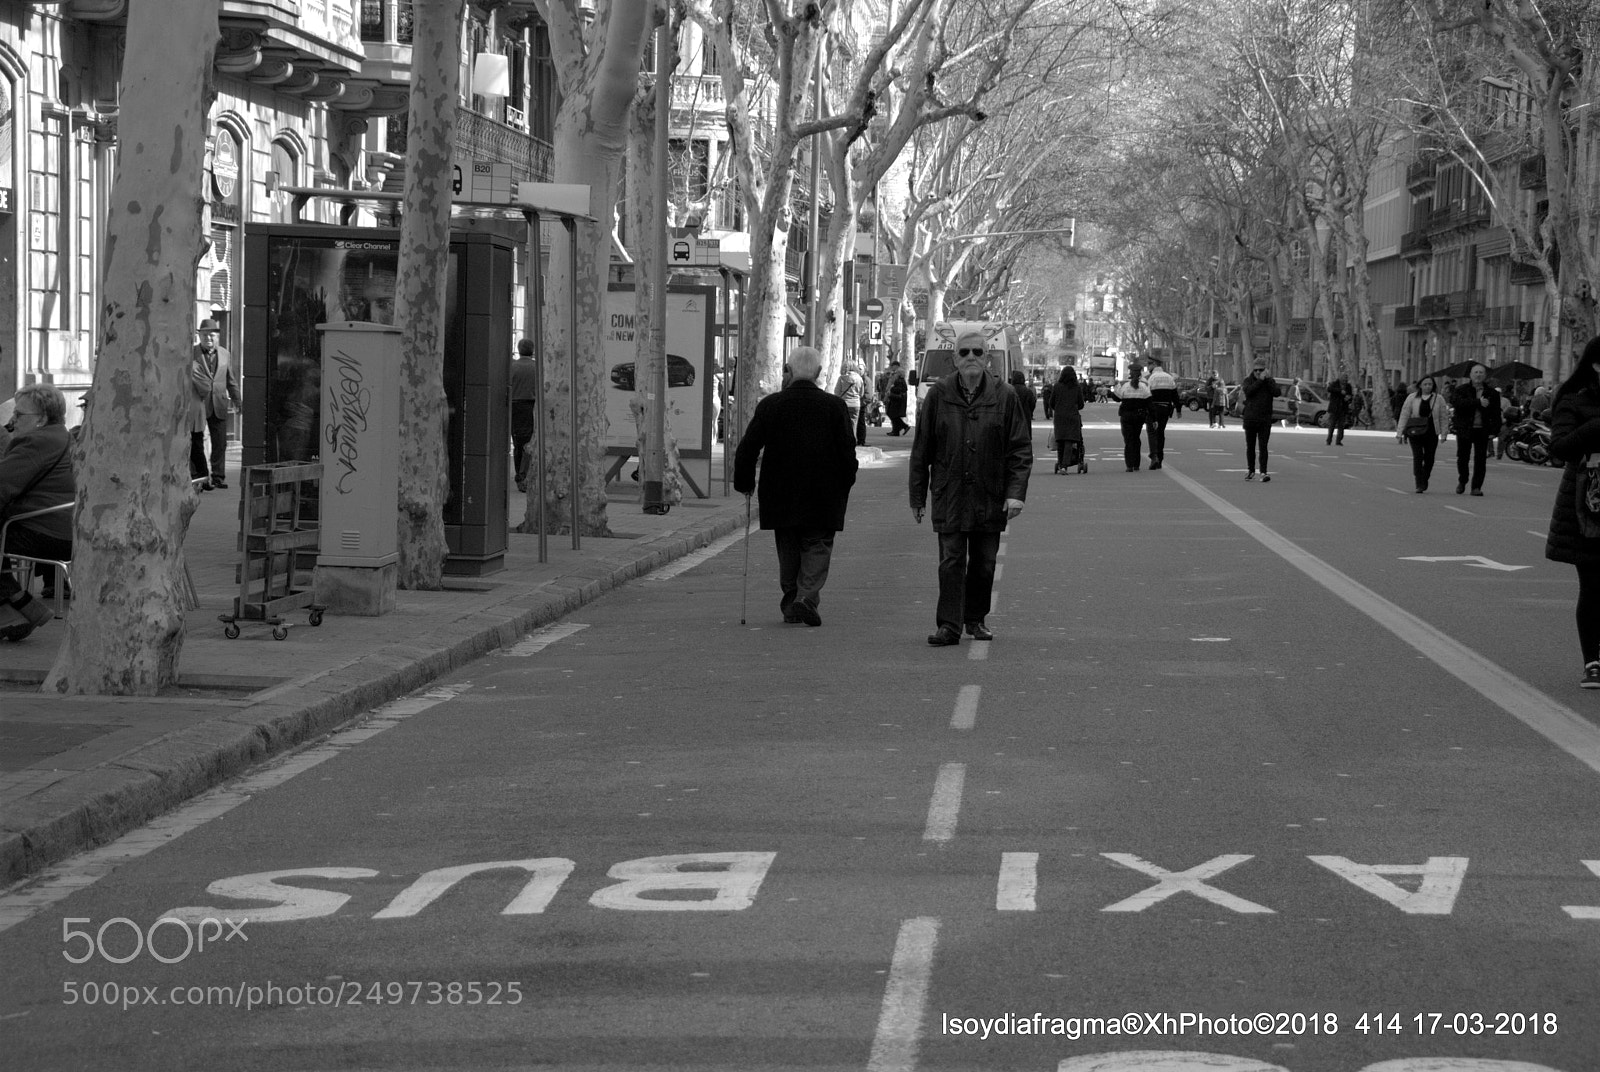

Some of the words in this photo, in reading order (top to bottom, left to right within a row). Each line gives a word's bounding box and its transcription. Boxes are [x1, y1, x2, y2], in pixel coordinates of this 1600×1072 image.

[474, 164, 491, 173] B20
[363, 242, 391, 250] Channel
[615, 330, 636, 342] NEW
[871, 322, 881, 339] P
[156, 851, 778, 924] BUS
